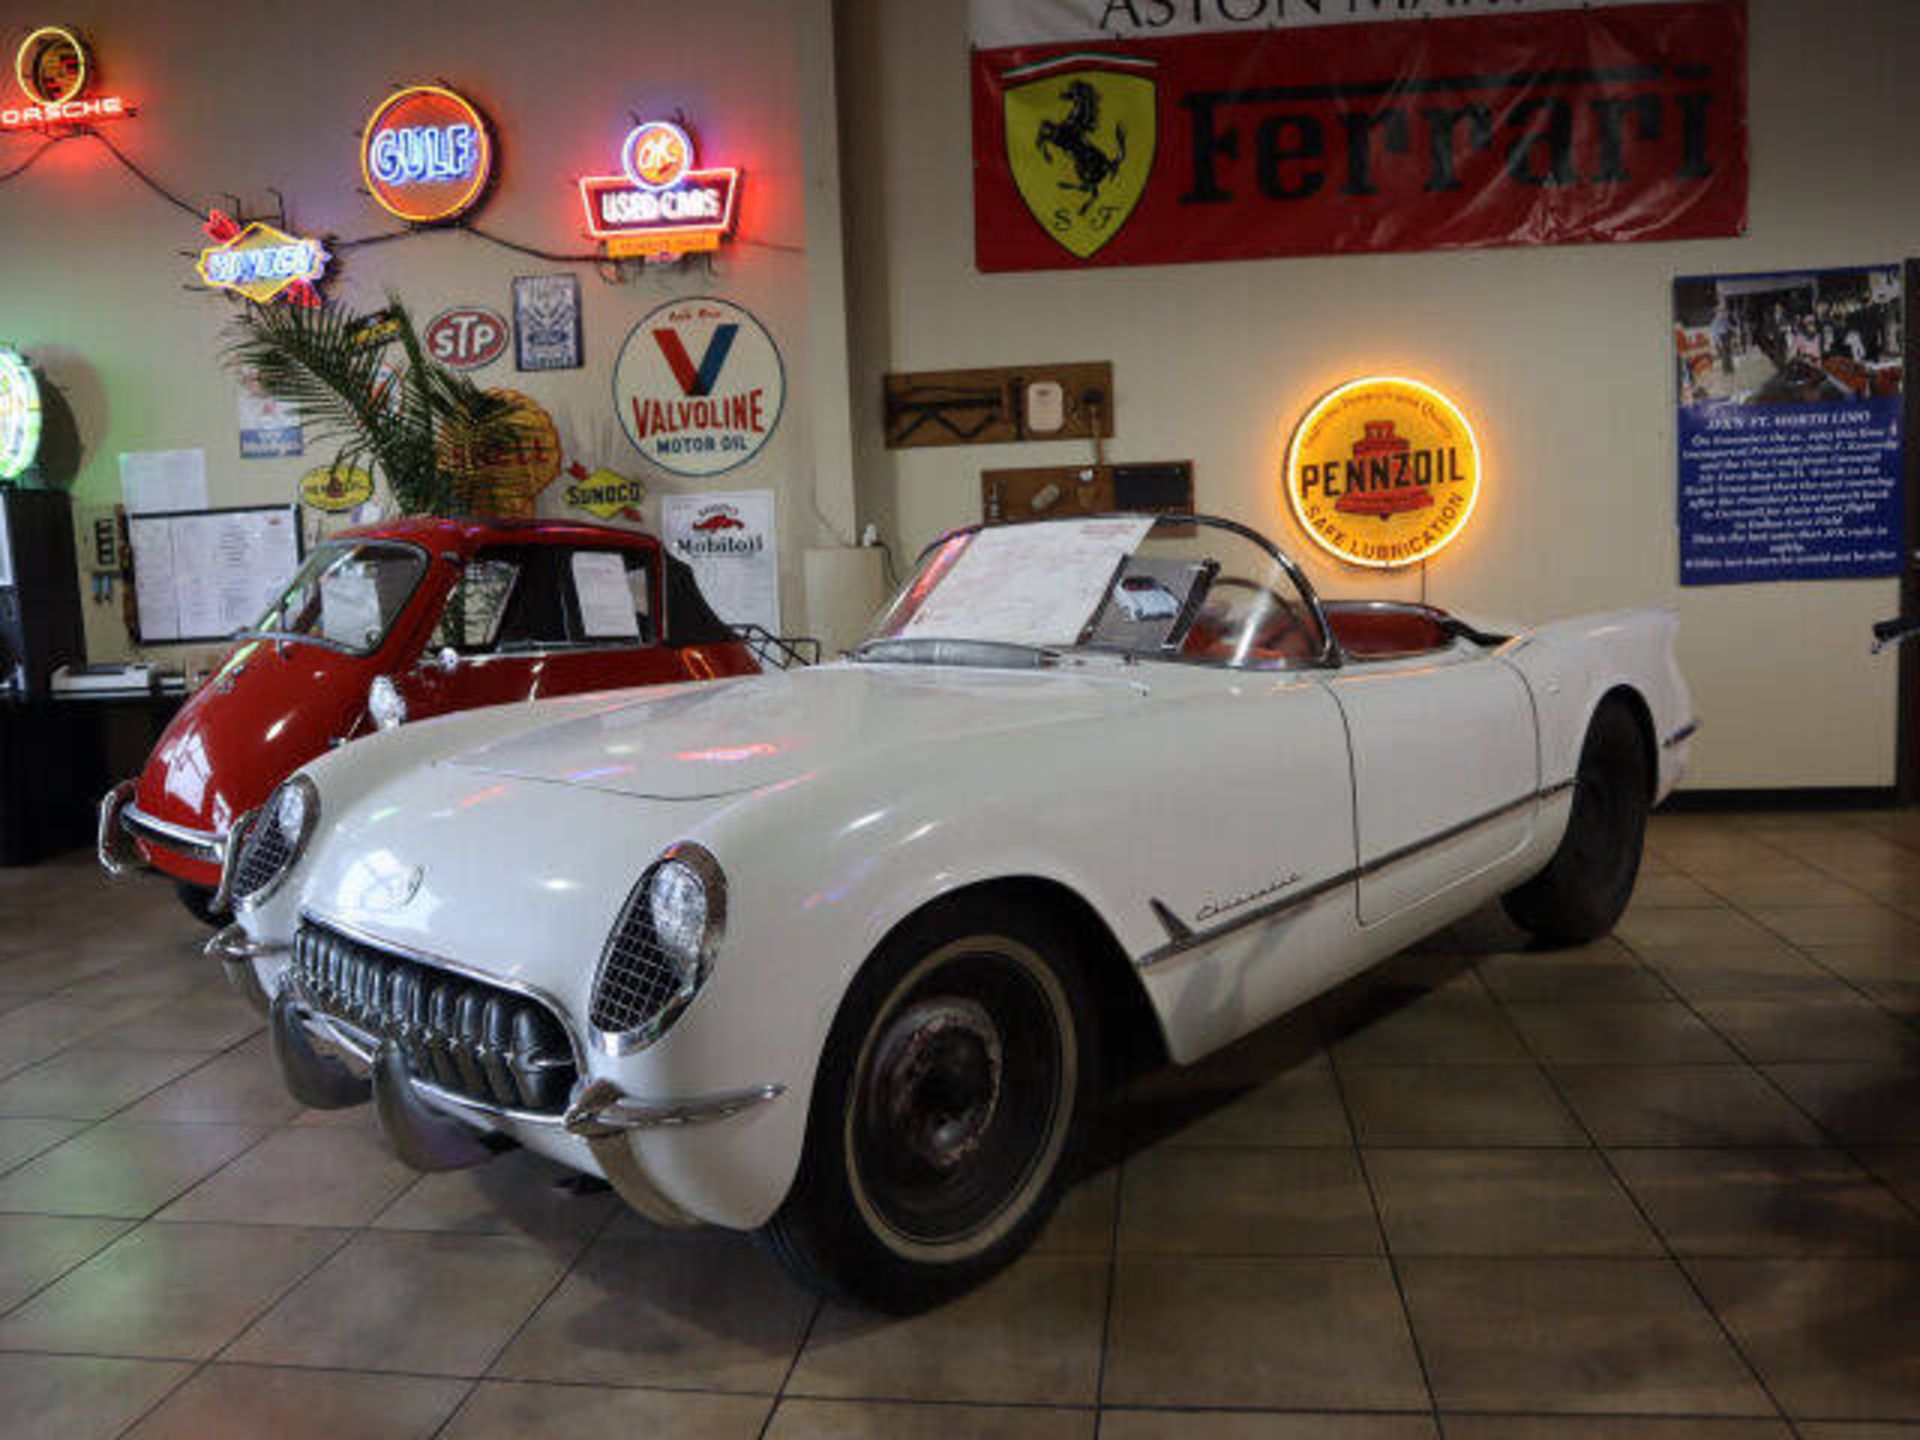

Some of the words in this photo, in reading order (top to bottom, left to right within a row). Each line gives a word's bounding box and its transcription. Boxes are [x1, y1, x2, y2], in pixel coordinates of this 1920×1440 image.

[1, 97, 122, 124] ORSCHE
[1180, 64, 1714, 205] Ferrari
[369, 124, 474, 184] GULF
[434, 315, 496, 358] STP
[632, 388, 766, 441] VALVOLINE
[656, 436, 716, 454] MOTOR
[720, 434, 749, 451] OIL
[566, 482, 641, 505] SUNOCO
[1301, 447, 1466, 500] PENNZOIL
[1304, 505, 1347, 548] SAFE
[1349, 490, 1465, 560] LUBRICATION
